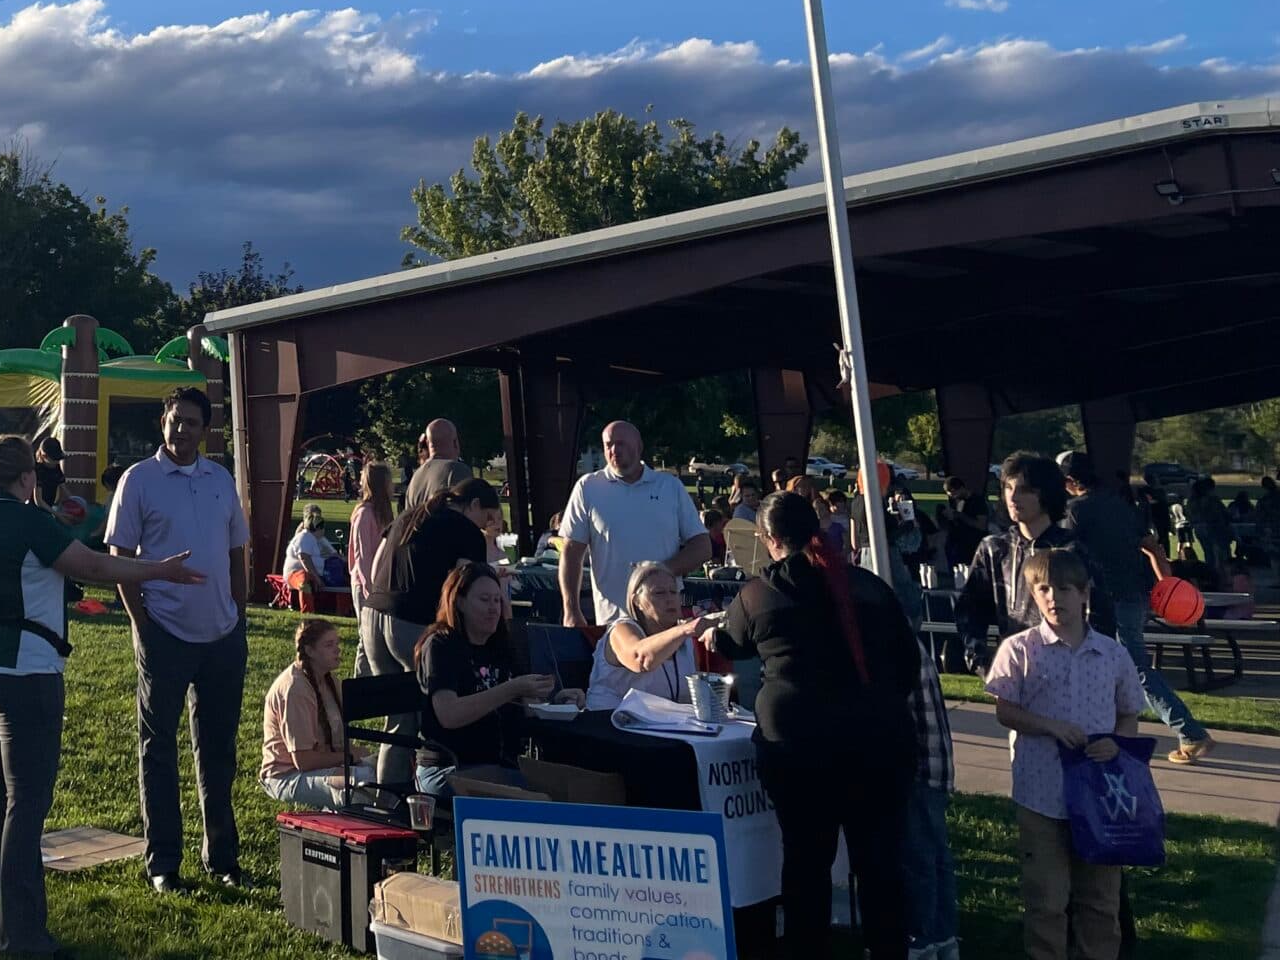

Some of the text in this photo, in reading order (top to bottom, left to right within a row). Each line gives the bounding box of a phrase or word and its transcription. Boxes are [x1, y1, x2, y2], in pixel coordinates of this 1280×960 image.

[1182, 116, 1223, 129] STAR
[709, 759, 761, 786] NORTH
[304, 848, 337, 864] CRAFTSMAN
[470, 832, 708, 884] FAMILY MEALTIME
[474, 874, 687, 907] STRENGTHENS family values,
[569, 906, 718, 933] communication,
[571, 925, 671, 949] traditions &
